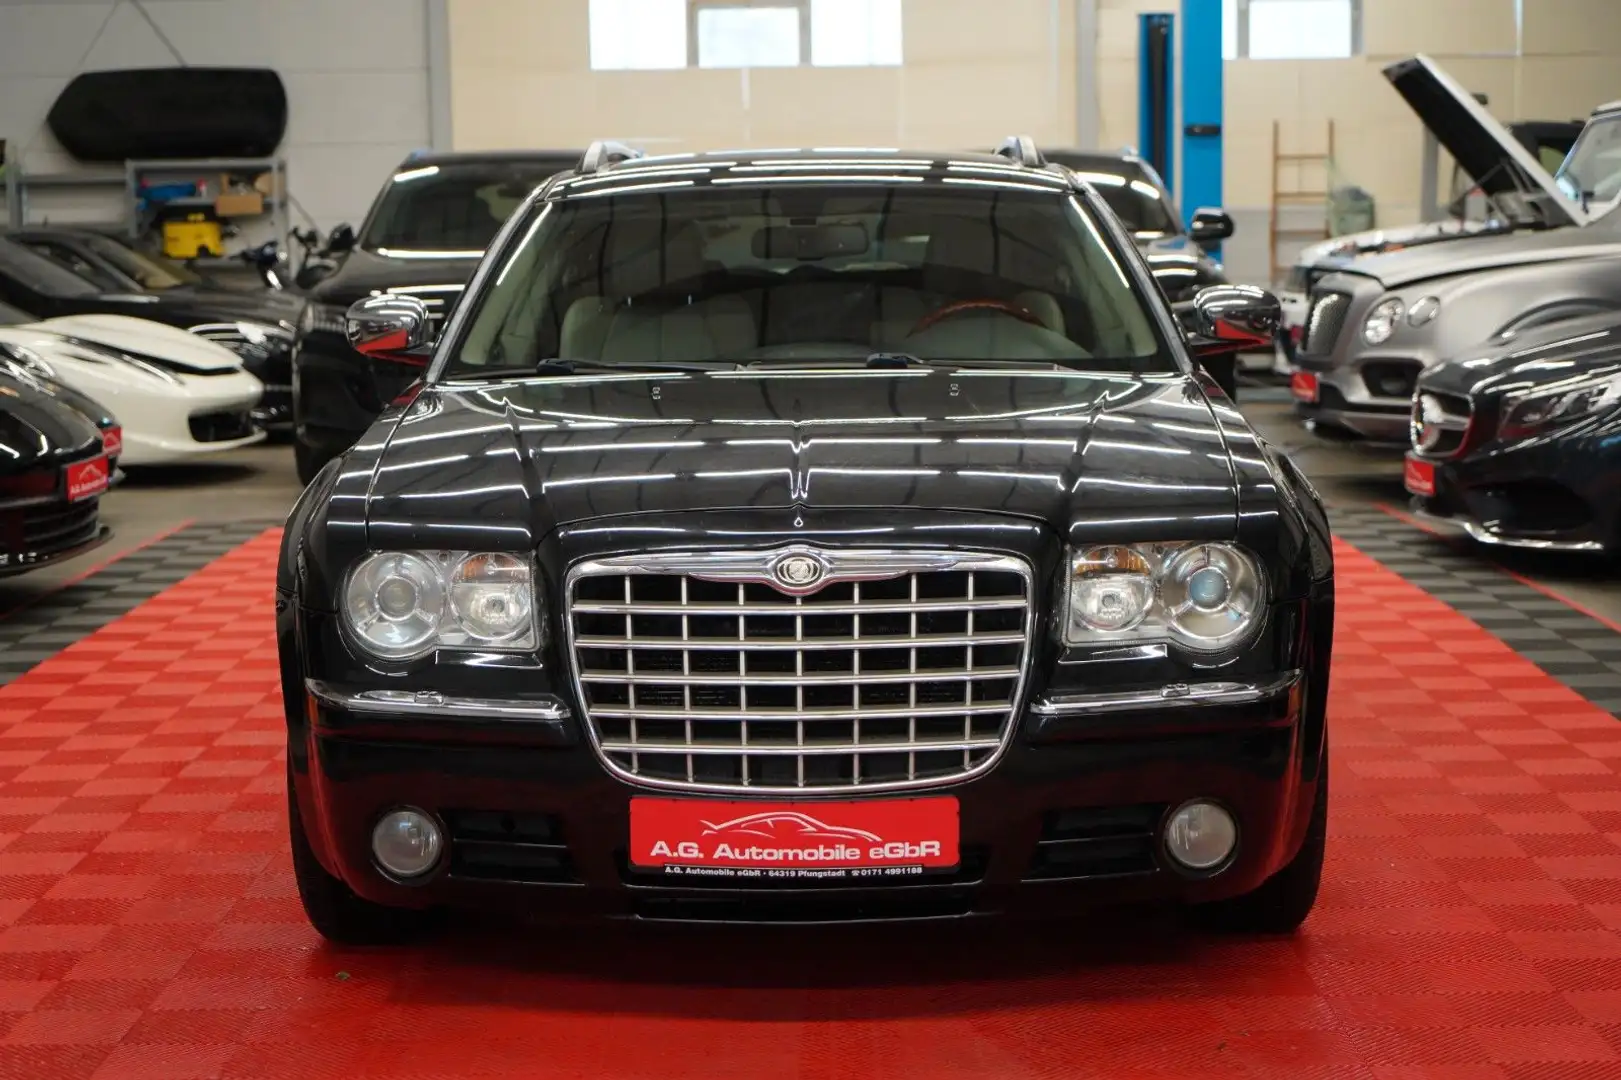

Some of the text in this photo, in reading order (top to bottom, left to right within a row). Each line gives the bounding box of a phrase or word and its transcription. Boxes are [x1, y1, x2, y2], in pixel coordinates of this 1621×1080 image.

[650, 840, 940, 861] A.G. Automobile eGbR
[665, 866, 683, 874] A.G.
[685, 867, 735, 876] Automobile
[737, 869, 761, 877] eGbR
[797, 869, 846, 879] Pfungstadt
